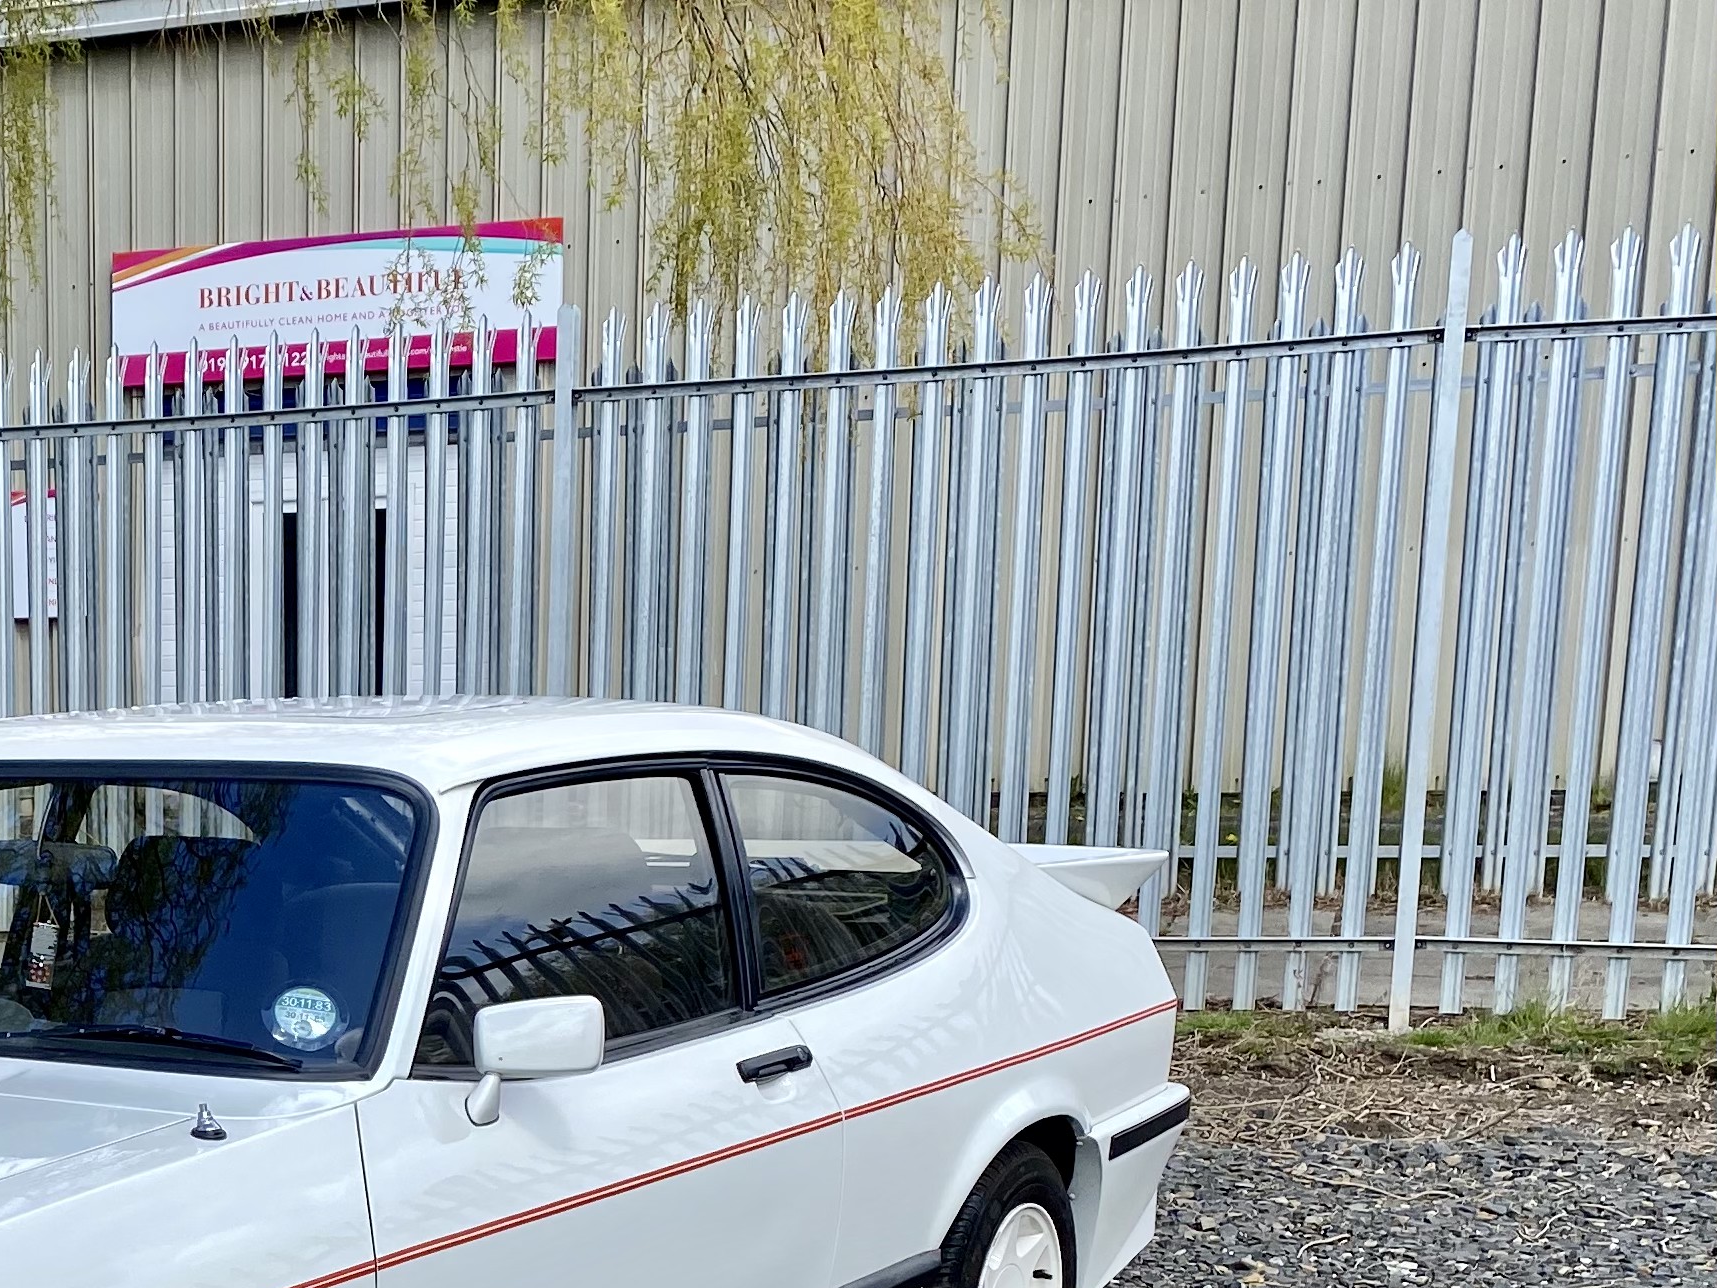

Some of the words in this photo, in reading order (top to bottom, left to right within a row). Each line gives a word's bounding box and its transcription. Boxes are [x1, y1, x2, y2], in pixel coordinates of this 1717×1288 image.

[198, 323, 206, 331] A
[208, 319, 274, 331] BEAUTIFULLY
[278, 315, 313, 326] CLEAN
[317, 312, 348, 323] HOME
[351, 311, 375, 320] AND
